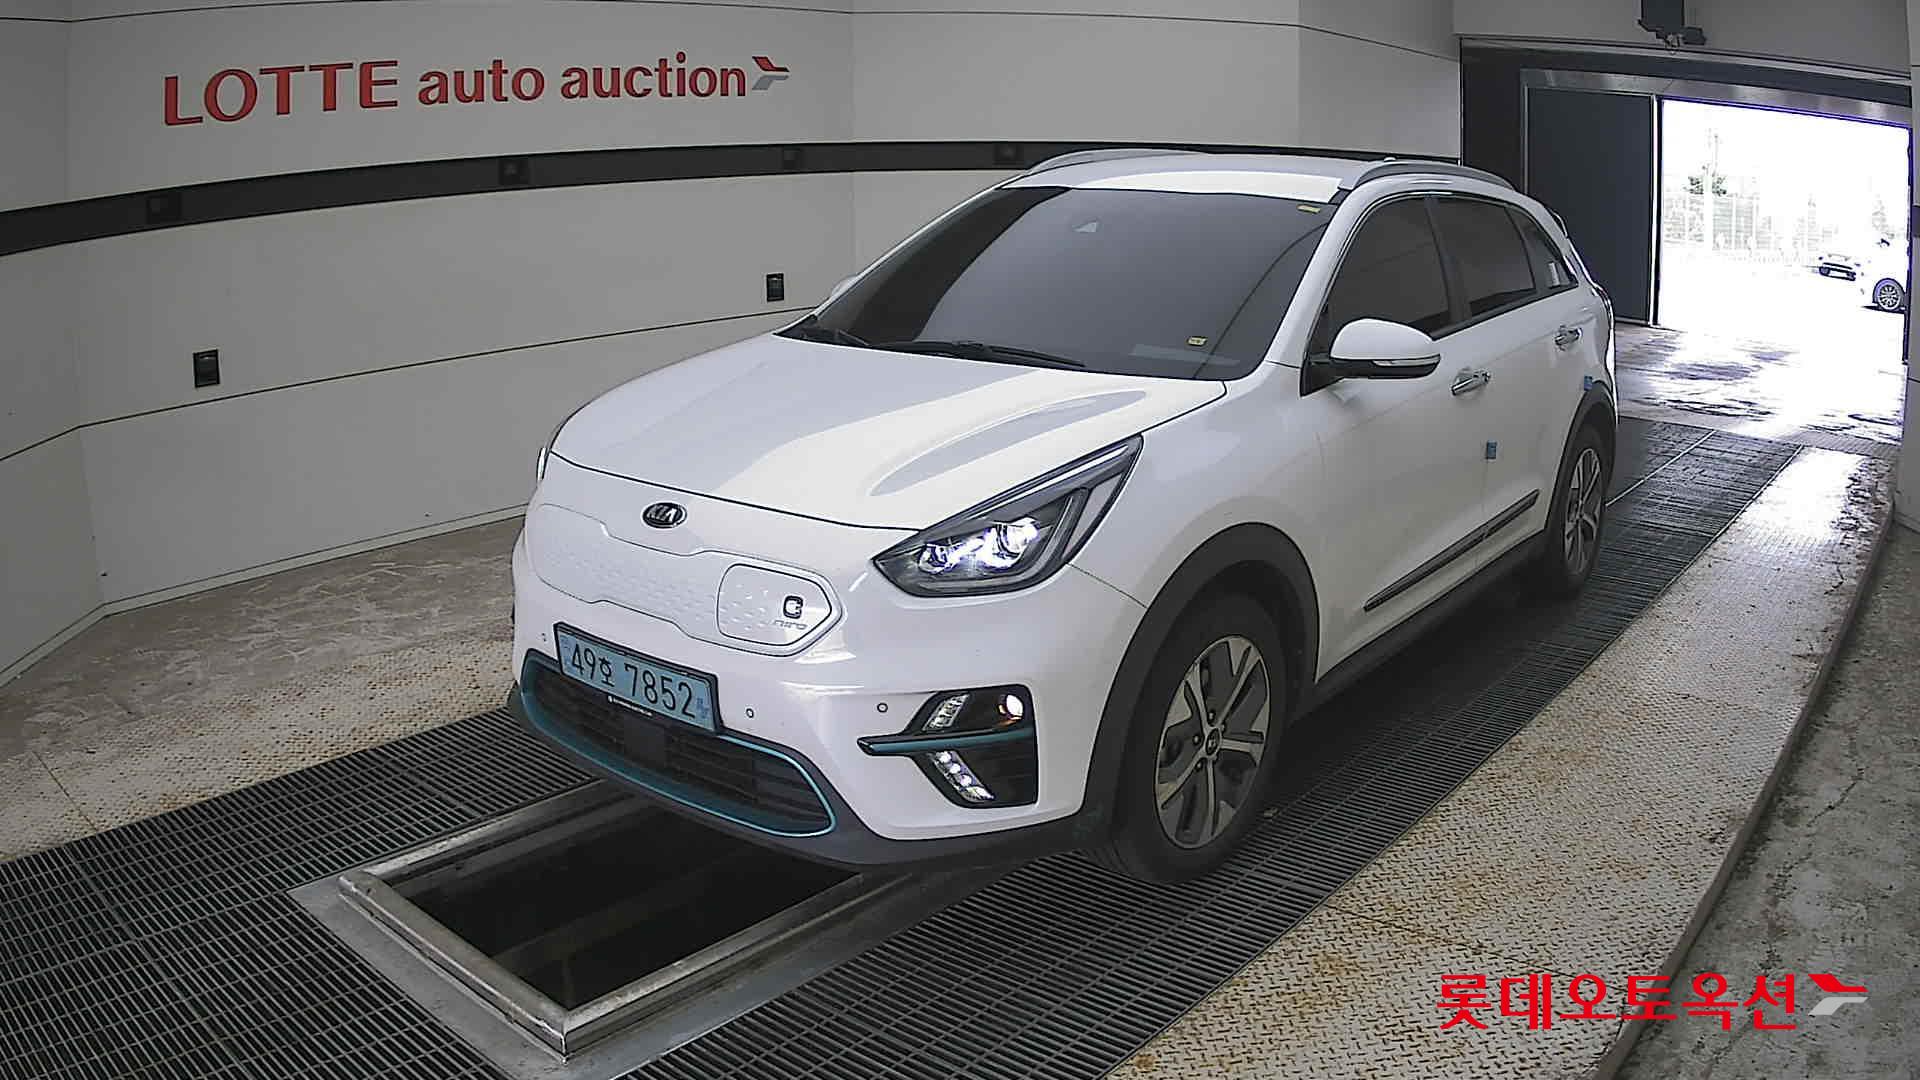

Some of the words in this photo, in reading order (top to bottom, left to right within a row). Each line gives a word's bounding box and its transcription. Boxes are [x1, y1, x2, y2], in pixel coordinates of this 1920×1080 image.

[164, 60, 400, 126] LOTTE
[417, 59, 546, 105] auto
[560, 51, 747, 98] auction
[572, 644, 615, 687] 49호
[624, 662, 696, 718] 7852
